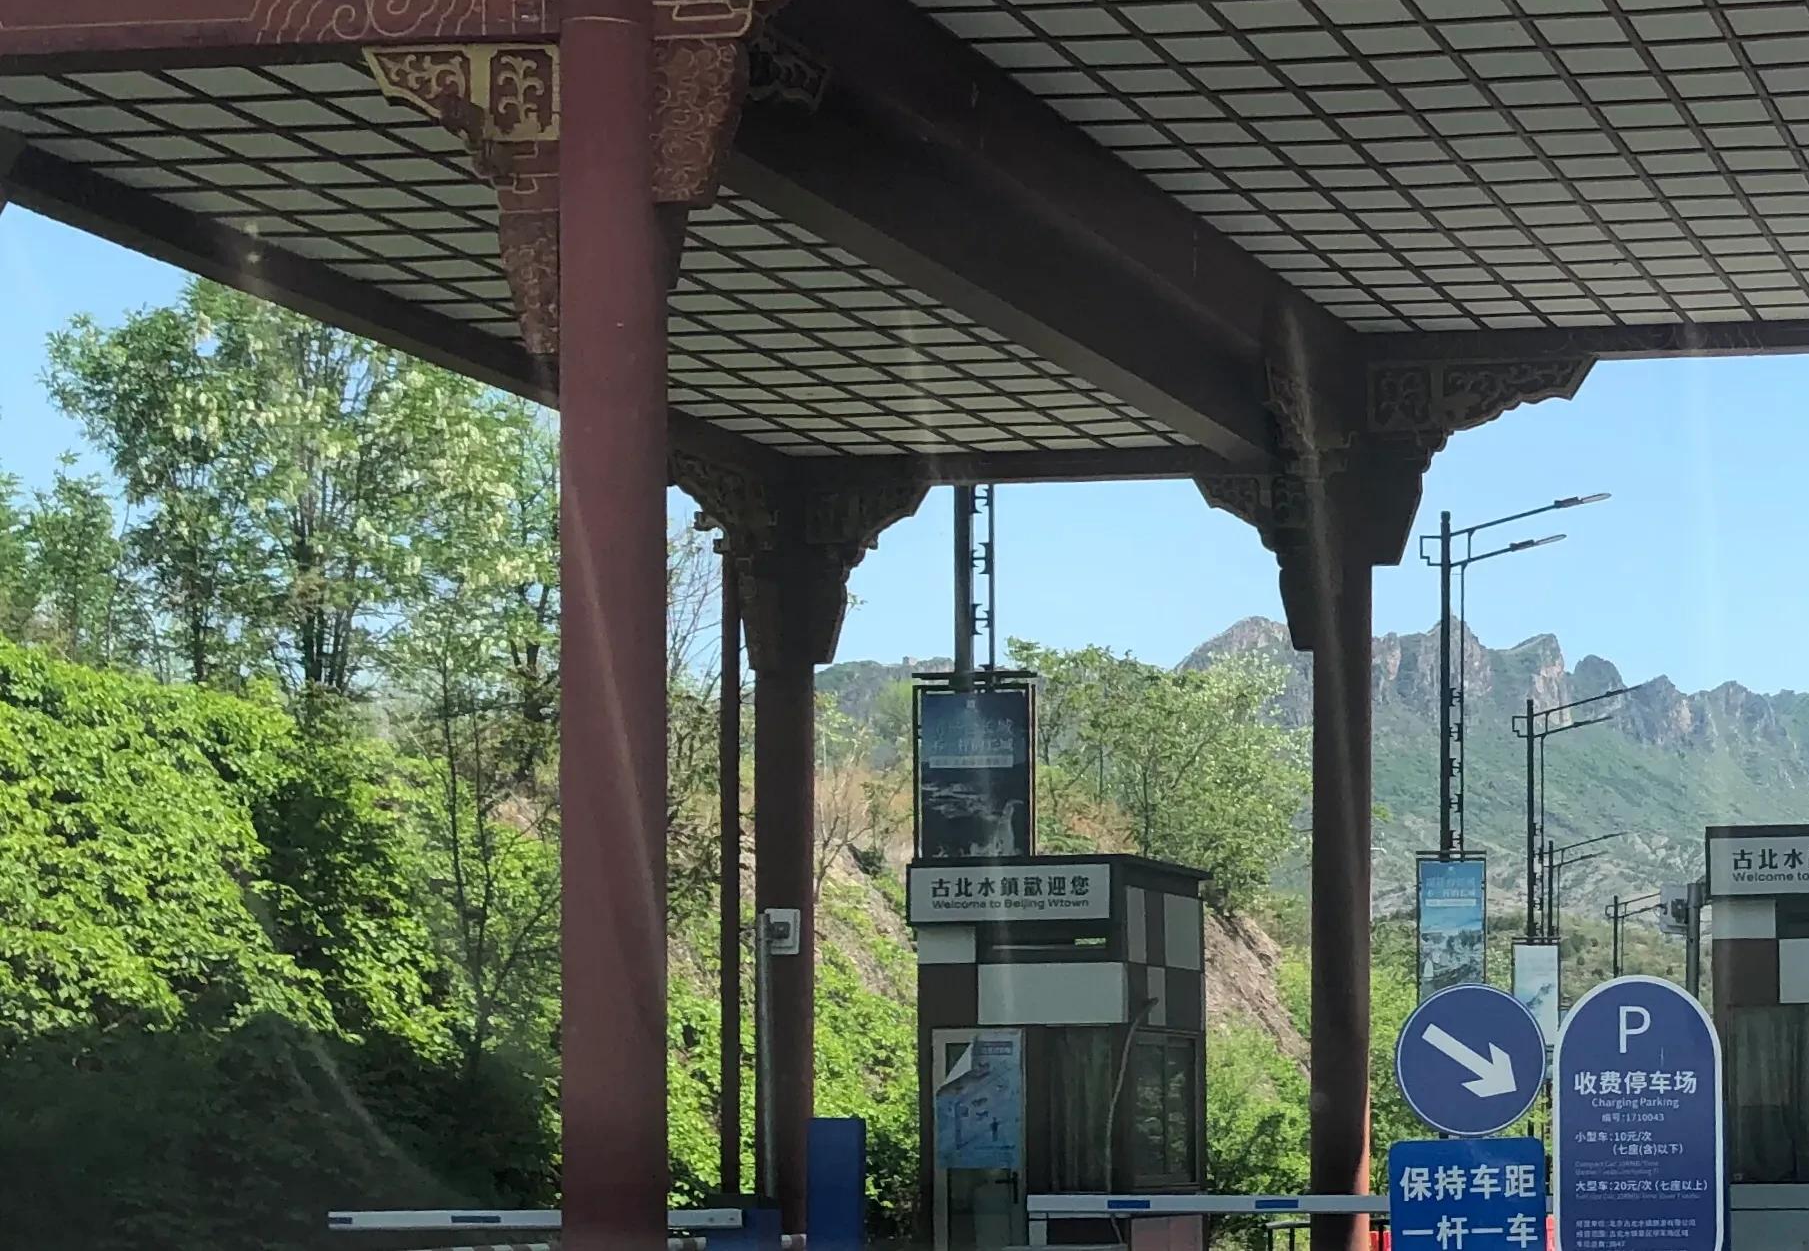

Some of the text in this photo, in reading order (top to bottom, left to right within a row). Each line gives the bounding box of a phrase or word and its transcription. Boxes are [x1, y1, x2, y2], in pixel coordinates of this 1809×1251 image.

[1732, 871, 1794, 882] Welcome
[1797, 871, 1809, 881] to
[932, 898, 1089, 910] Welcome to Beijing Wtown
[1618, 1005, 1651, 1054] P
[1574, 1070, 1697, 1095] 收费停车场
[1591, 1098, 1680, 1109] Charging Parking
[1399, 1163, 1537, 1202] 保持车距
[1402, 1212, 1539, 1250] 一杆一车
